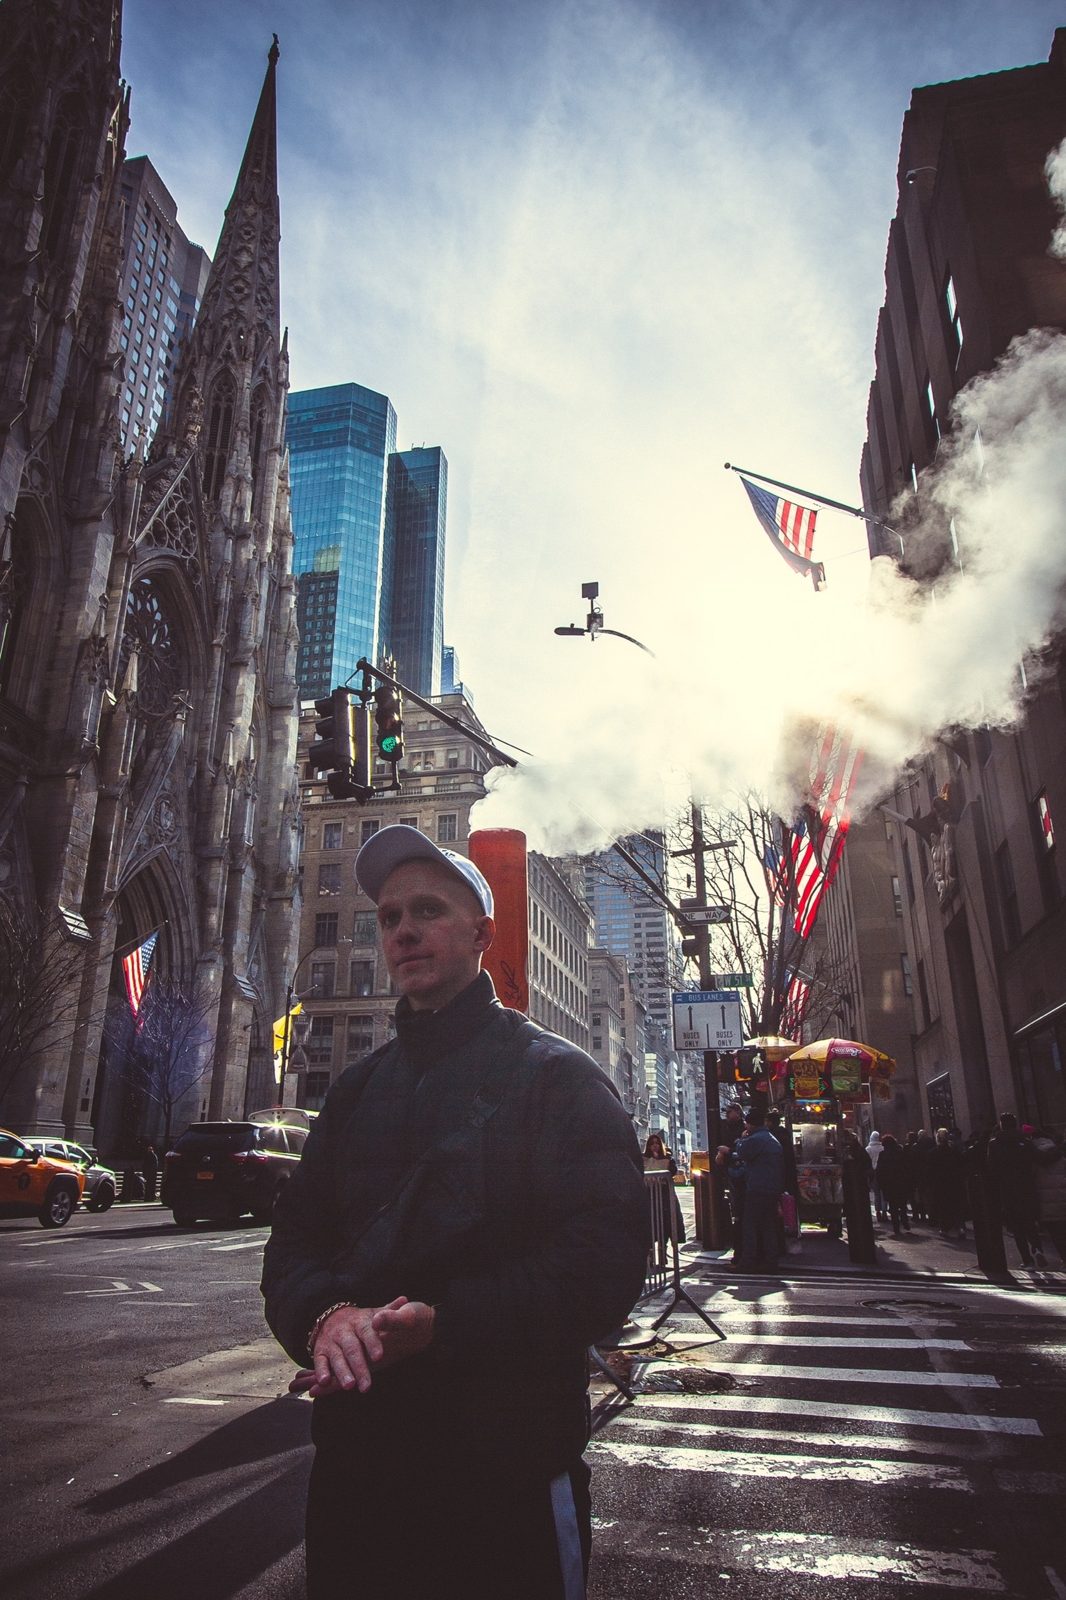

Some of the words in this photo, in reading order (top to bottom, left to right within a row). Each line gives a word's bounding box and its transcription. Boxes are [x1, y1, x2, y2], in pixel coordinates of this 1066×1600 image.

[704, 911, 723, 919] WAY
[702, 993, 724, 1001] LANES
[683, 1032, 700, 1040] BUSES
[715, 1030, 734, 1039] BUSES
[684, 1040, 699, 1048] ONLY
[717, 1039, 733, 1047] ONLY
